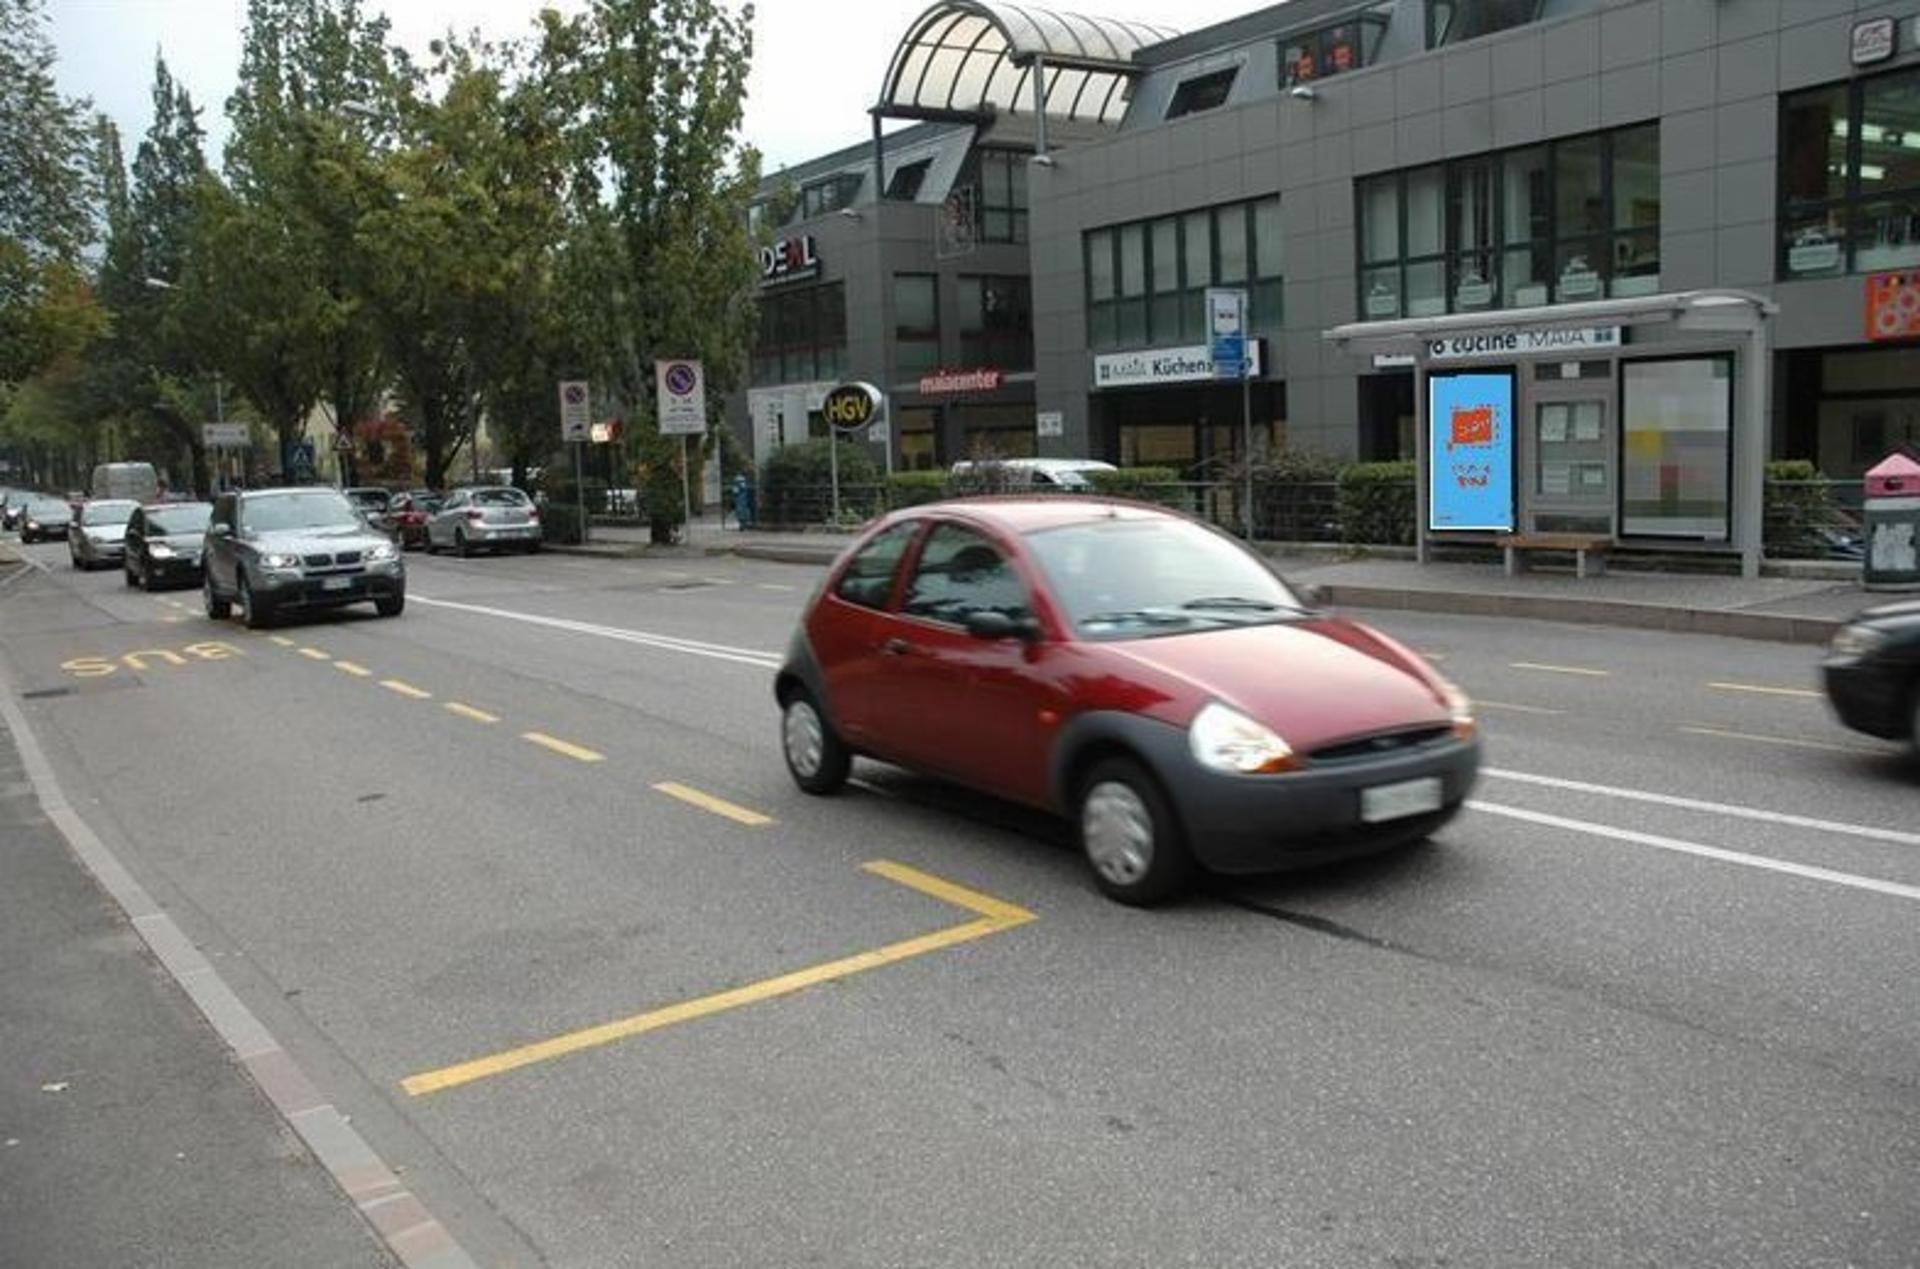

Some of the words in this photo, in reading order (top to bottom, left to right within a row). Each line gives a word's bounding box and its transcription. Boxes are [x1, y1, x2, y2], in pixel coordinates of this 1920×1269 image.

[1451, 331, 1517, 353] cucine
[828, 395, 868, 419] HGV
[61, 641, 248, 677] BUS
